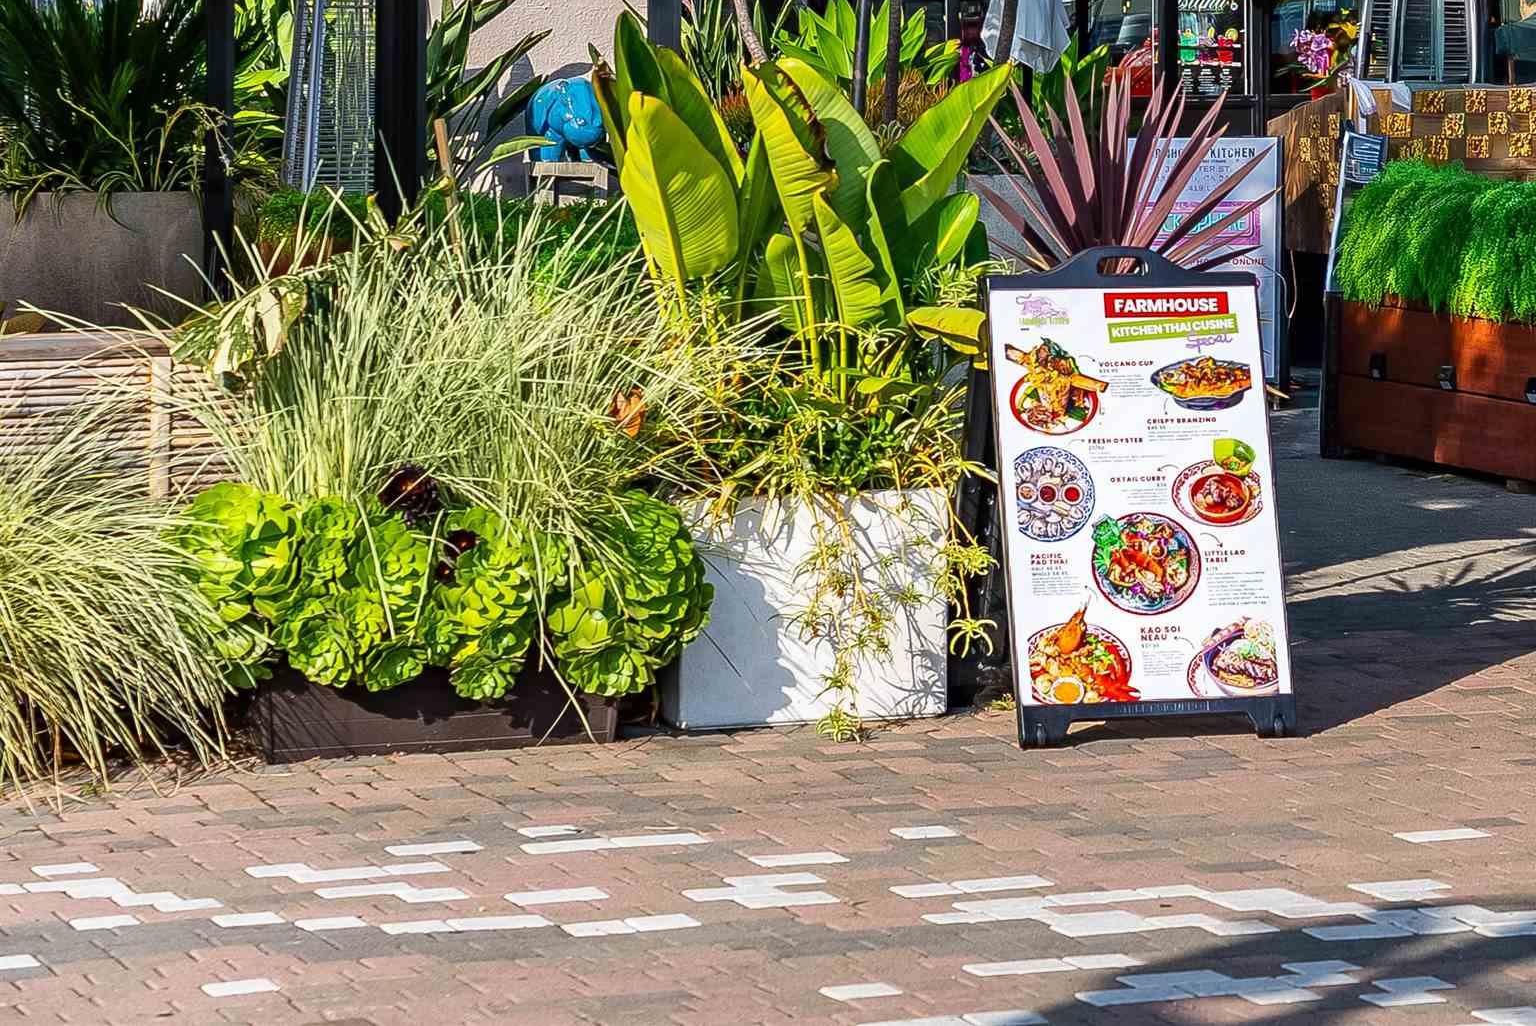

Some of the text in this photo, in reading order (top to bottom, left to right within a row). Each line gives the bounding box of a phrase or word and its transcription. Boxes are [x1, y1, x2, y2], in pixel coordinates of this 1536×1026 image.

[1232, 258, 1265, 266] ONLINE
[1114, 297, 1219, 313] FARMHOUSE
[1111, 323, 1163, 338] KITCHEN
[1138, 359, 1154, 367] CUP
[1140, 625, 1181, 634] KAO SOI
[1140, 634, 1168, 642] NEAU
